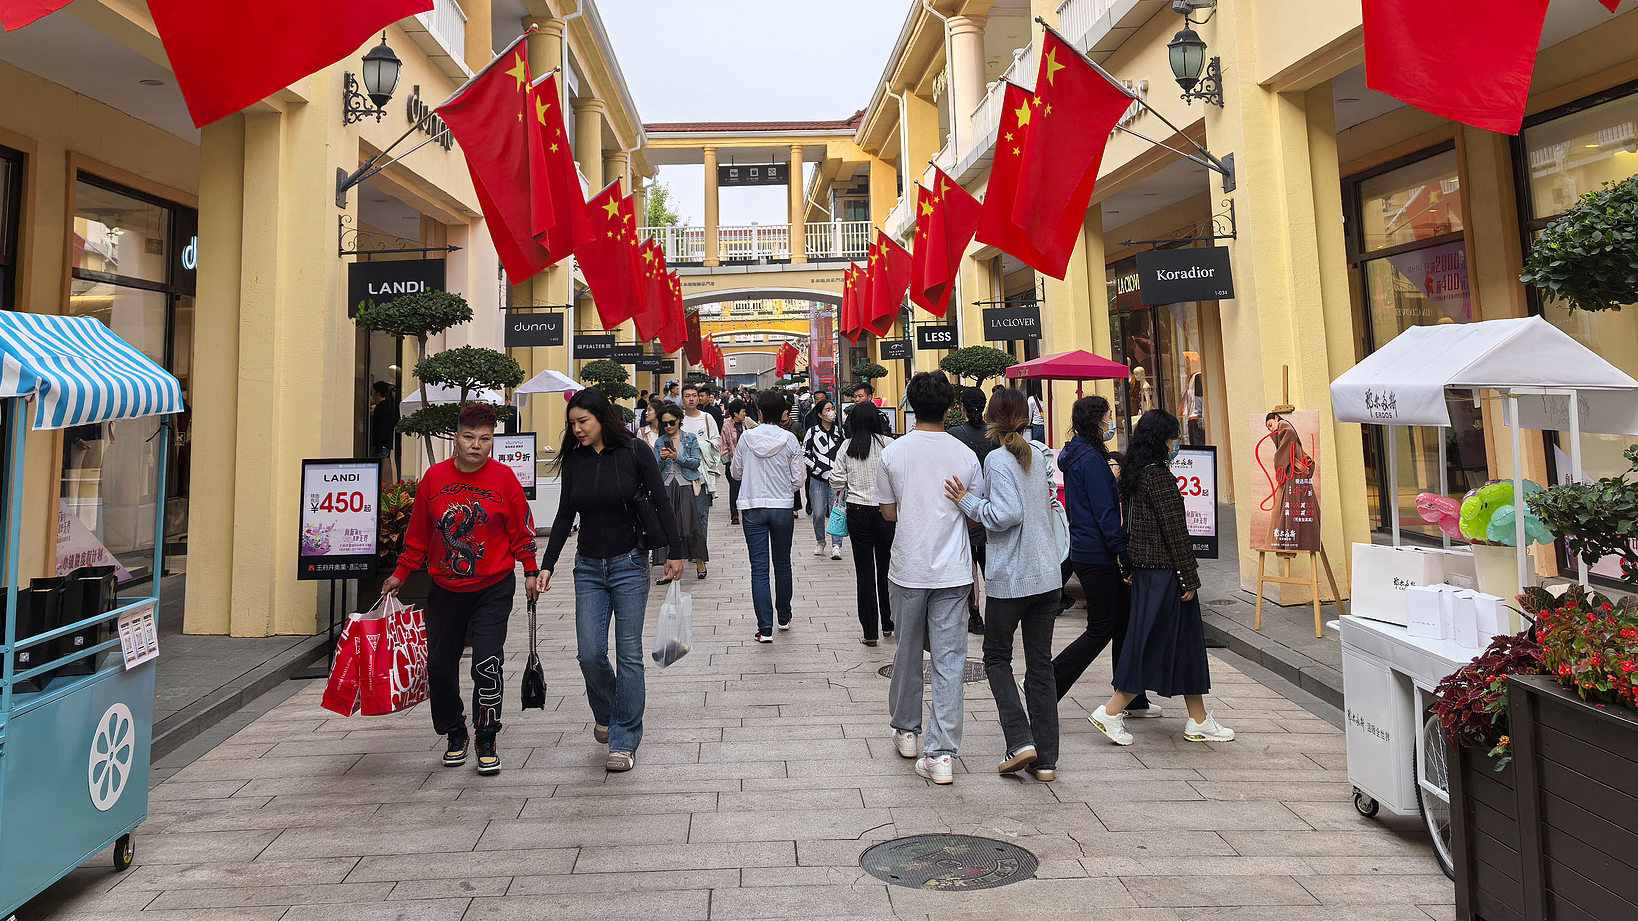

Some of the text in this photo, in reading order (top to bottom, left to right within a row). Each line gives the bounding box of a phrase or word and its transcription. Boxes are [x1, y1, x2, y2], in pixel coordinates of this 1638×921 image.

[1156, 265, 1215, 281] Koradior
[368, 280, 424, 295] LANDI
[1125, 273, 1141, 293] CLOV
[514, 321, 556, 331] dunnu
[991, 317, 1035, 328] LA CLOVER
[925, 331, 952, 342] LESS
[498, 451, 531, 463] 再享9折
[1255, 427, 1315, 511] Sale
[323, 473, 360, 482] LANDI
